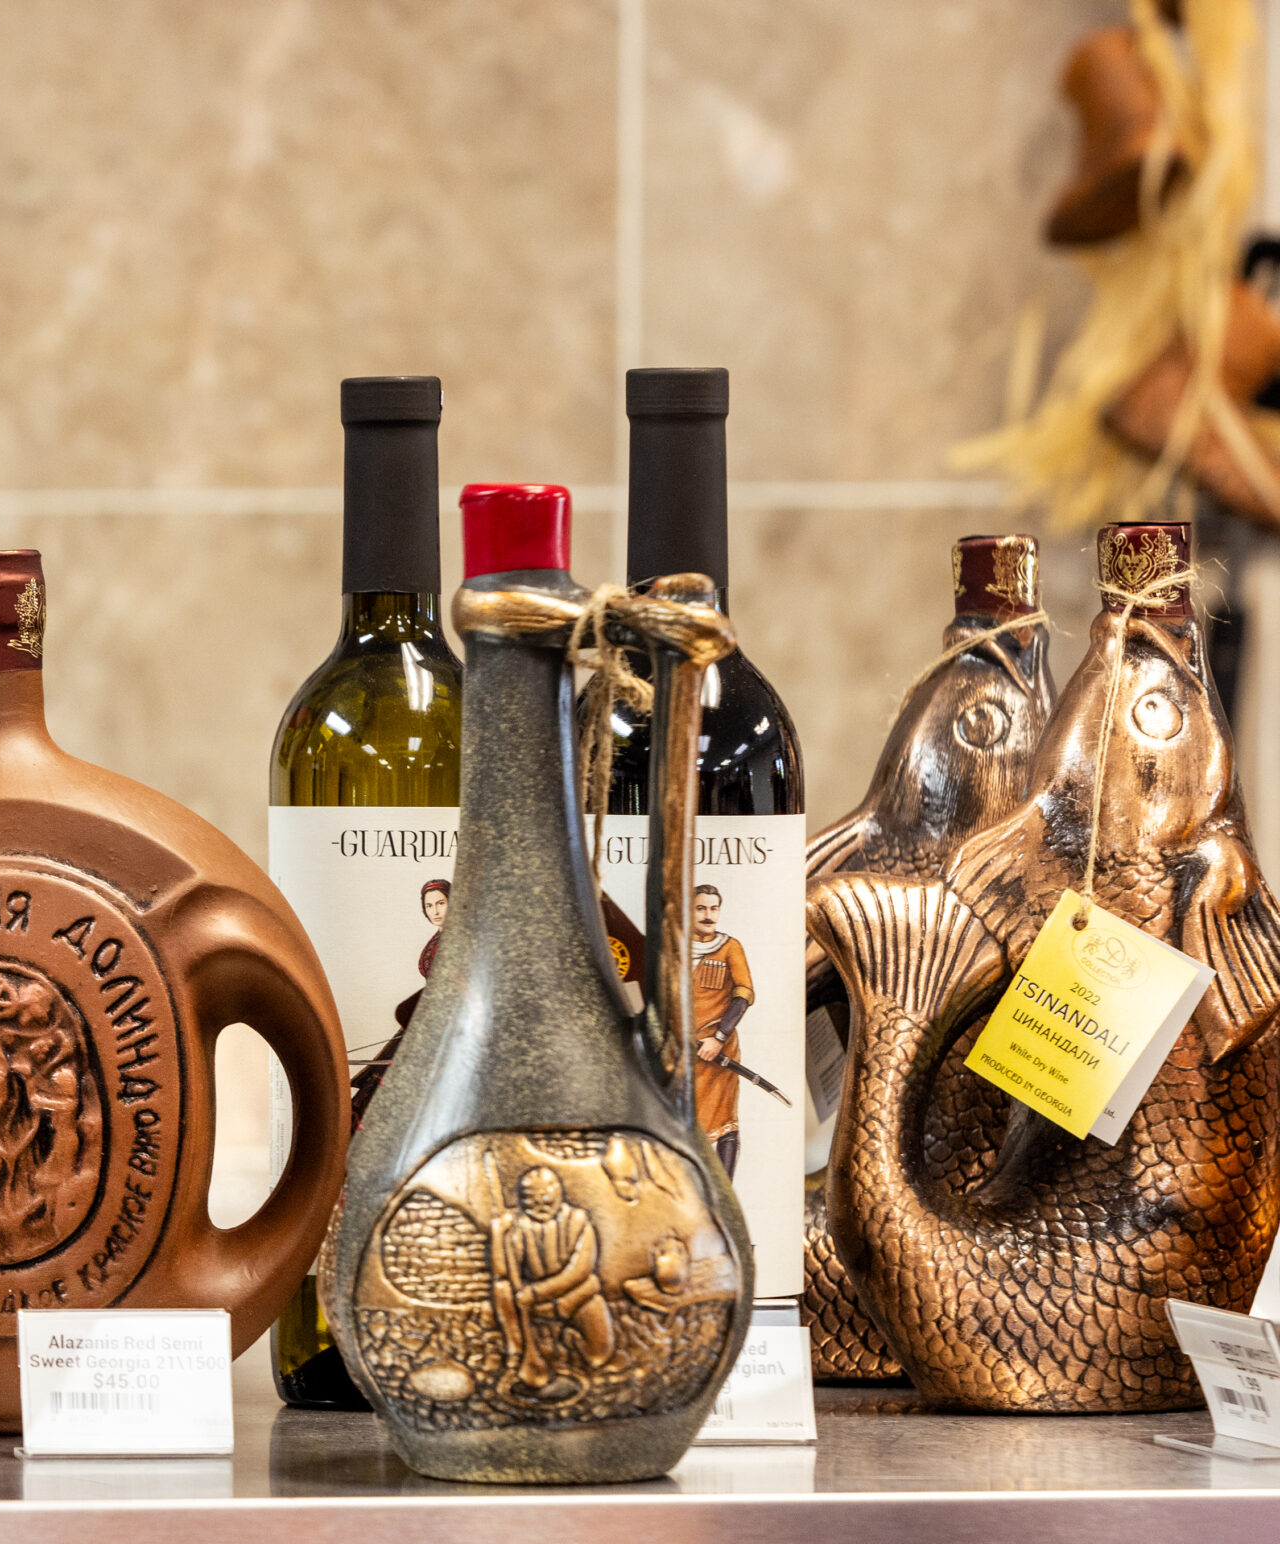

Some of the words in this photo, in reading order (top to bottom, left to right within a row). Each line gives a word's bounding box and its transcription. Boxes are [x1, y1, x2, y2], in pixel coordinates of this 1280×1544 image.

[51, 914, 162, 1106] ДОЛИНА
[1014, 974, 1131, 1057] TSINANDALI
[1070, 982, 1101, 1006] 2022
[1012, 1008, 1101, 1070] ЦИНАНДАЛИ
[980, 1053, 1023, 1086] PRODUCED
[1023, 1080, 1035, 1092] IN
[1034, 1088, 1073, 1117] GEORGIA
[1009, 1041, 1032, 1062] White
[1032, 1056, 1048, 1072] Dry
[1049, 1066, 1070, 1085] Wine
[29, 1354, 81, 1369] Sweet
[85, 1354, 151, 1373] Georgia
[48, 1334, 119, 1351] Alazanis
[124, 1335, 156, 1351] Red
[161, 1335, 204, 1351] Semi
[93, 1371, 160, 1390] $45.00
